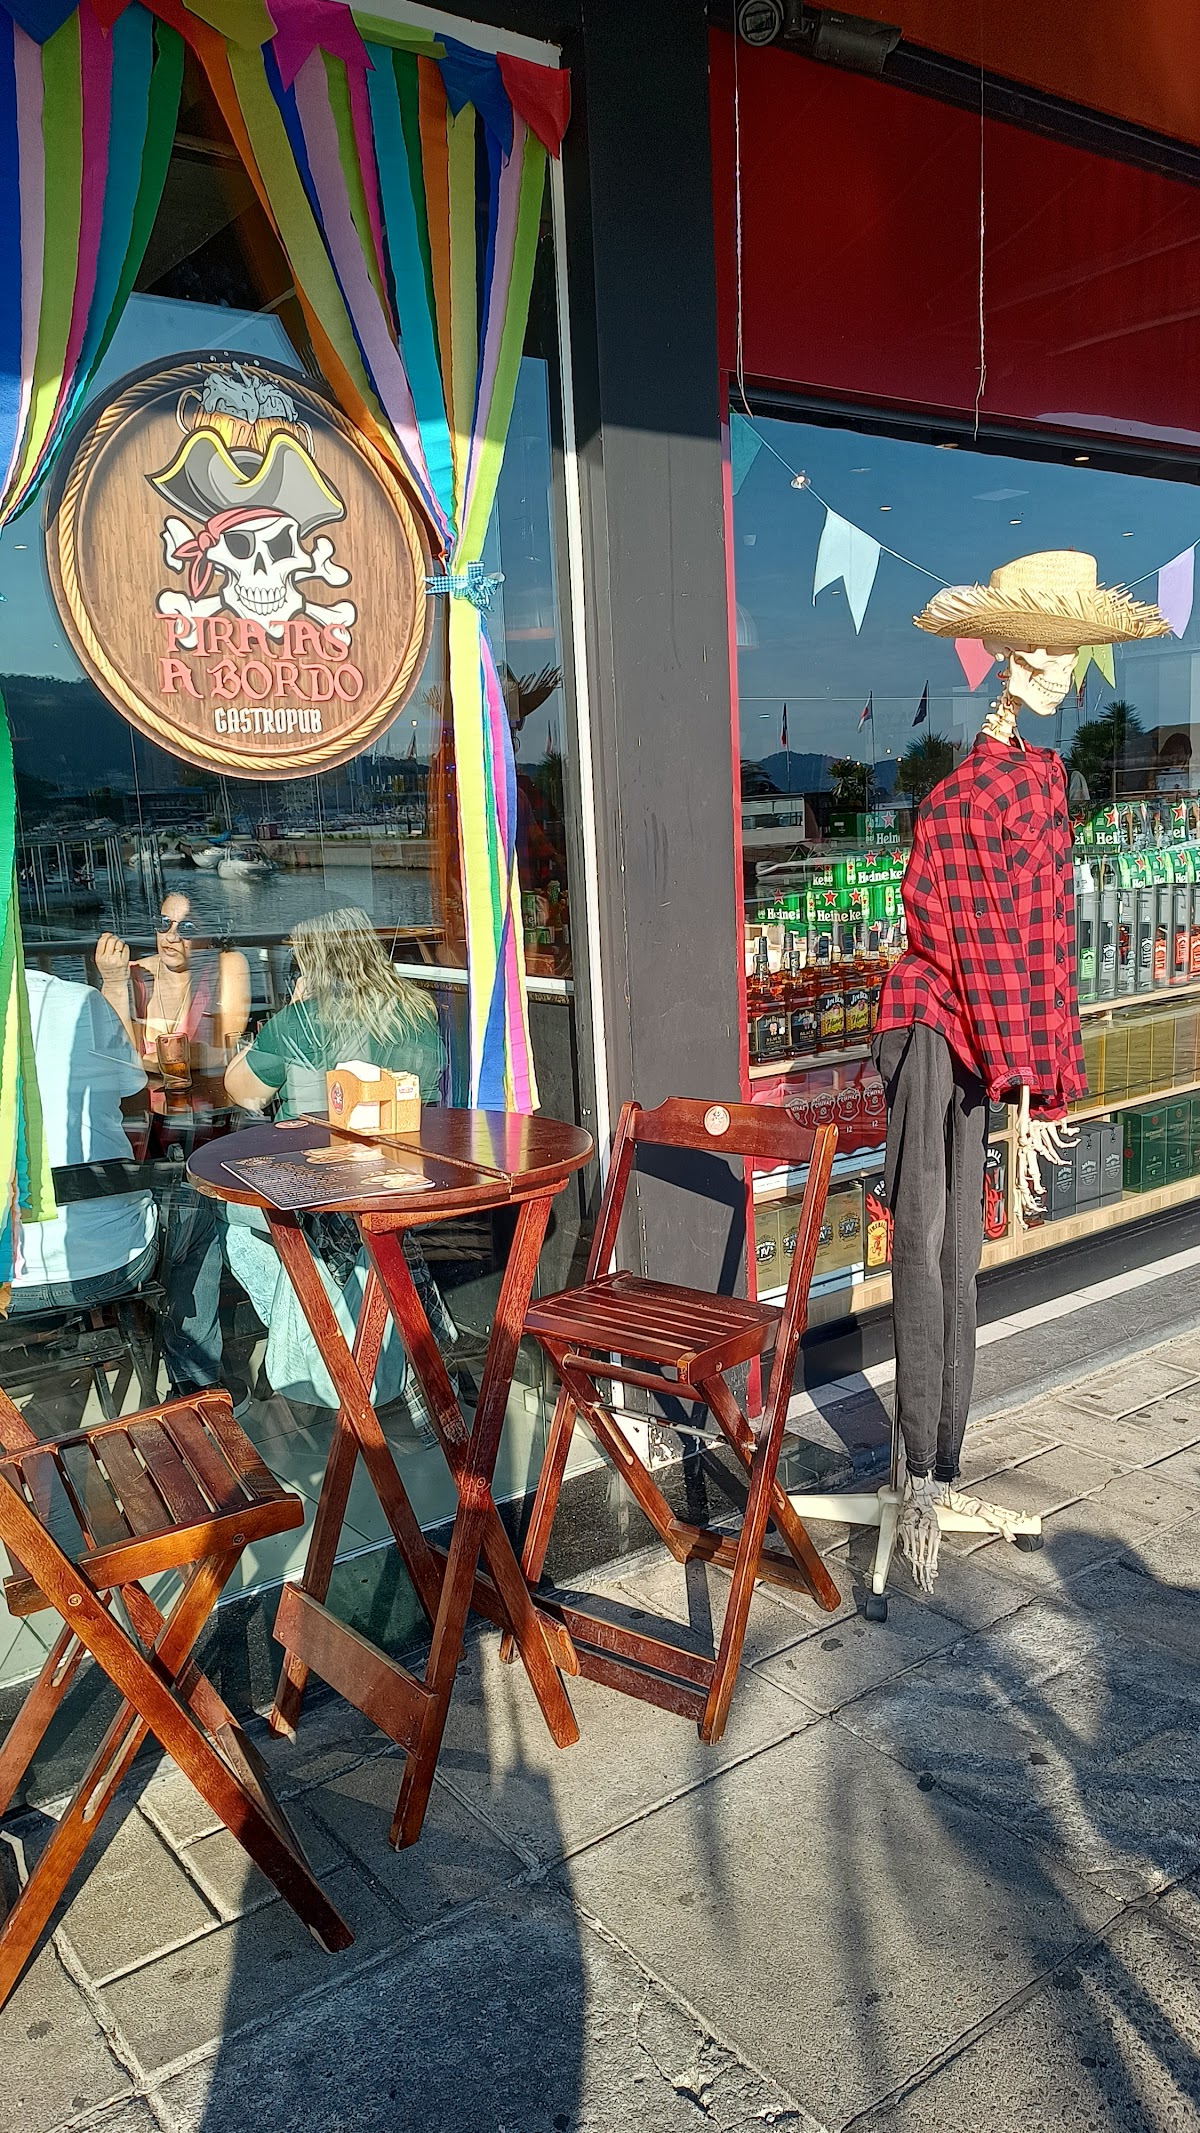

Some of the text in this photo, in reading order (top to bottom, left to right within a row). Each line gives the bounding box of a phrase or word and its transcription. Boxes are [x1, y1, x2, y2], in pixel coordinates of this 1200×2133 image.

[155, 612, 349, 661] PIRATAS
[159, 658, 363, 701] A BORDO
[214, 706, 323, 734] GASTROPUB
[858, 868, 903, 884] Heineke
[817, 909, 862, 922] Heineke
[846, 1125, 853, 1133] 12
